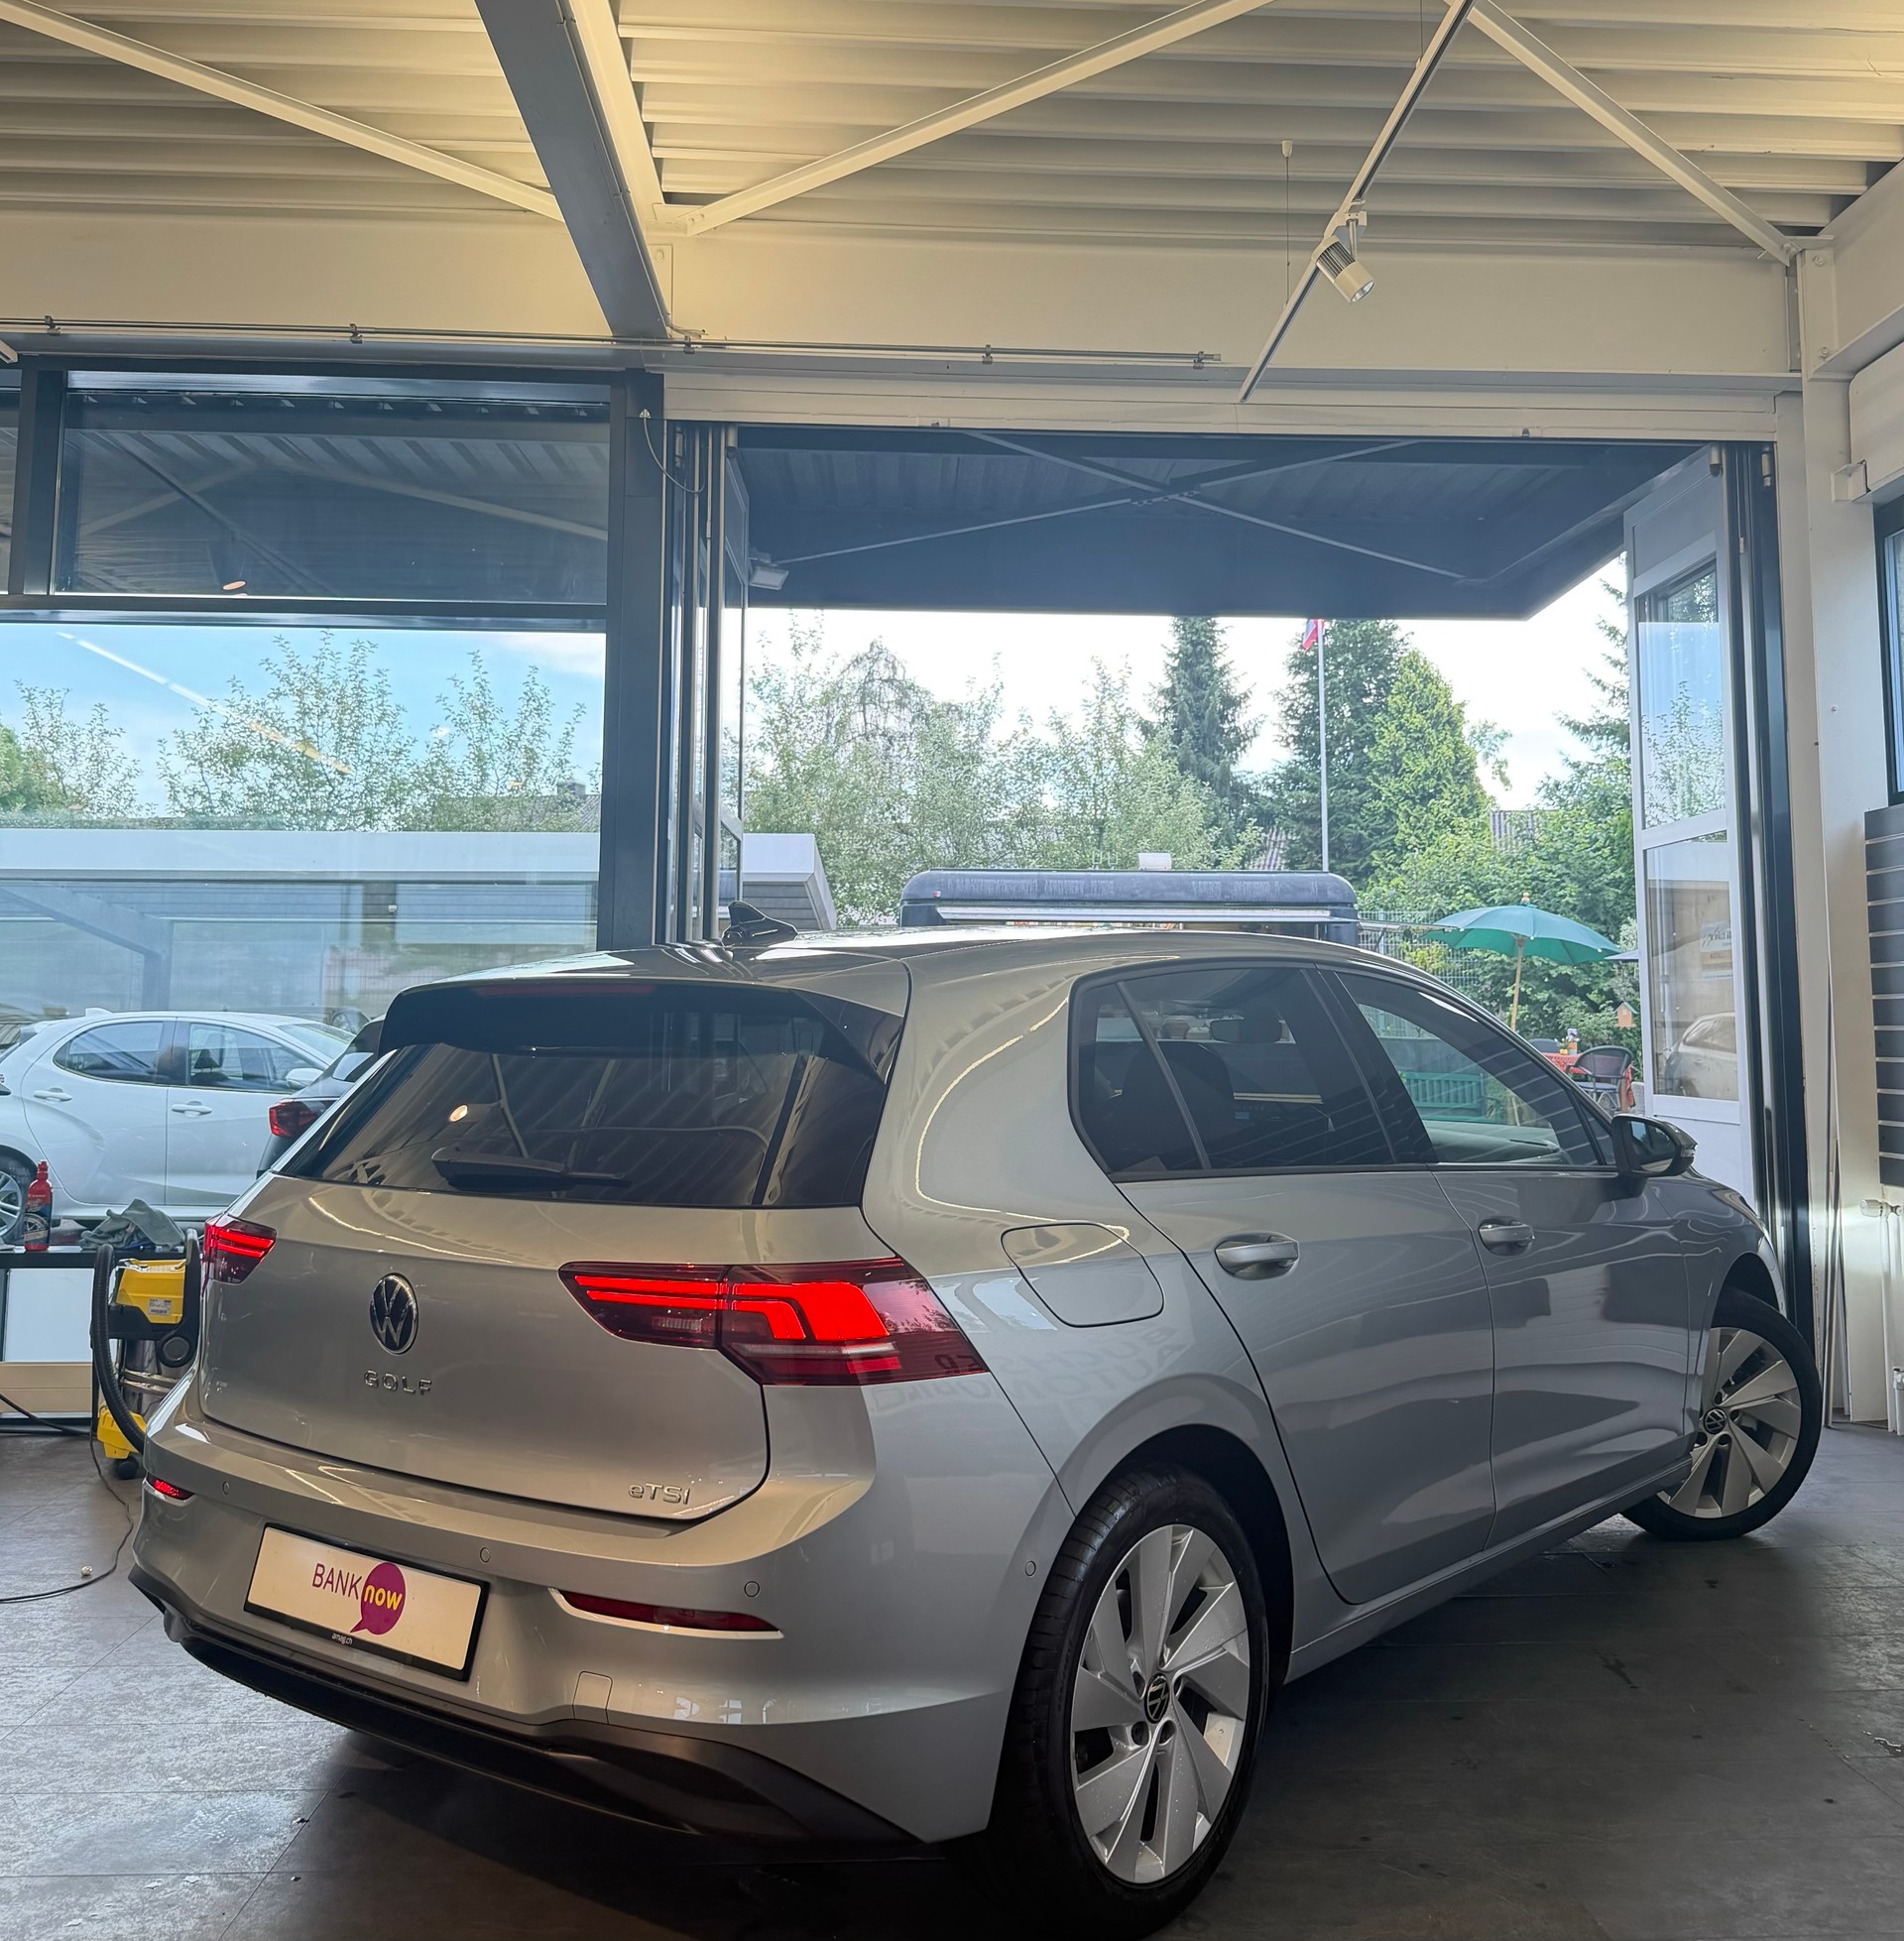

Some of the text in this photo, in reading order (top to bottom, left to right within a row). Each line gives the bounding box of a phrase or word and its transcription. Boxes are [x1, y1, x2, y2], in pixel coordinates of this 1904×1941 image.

[363, 1370, 432, 1396] GOLF
[628, 1483, 691, 1506] eTSI
[312, 1563, 403, 1611] BANK now
